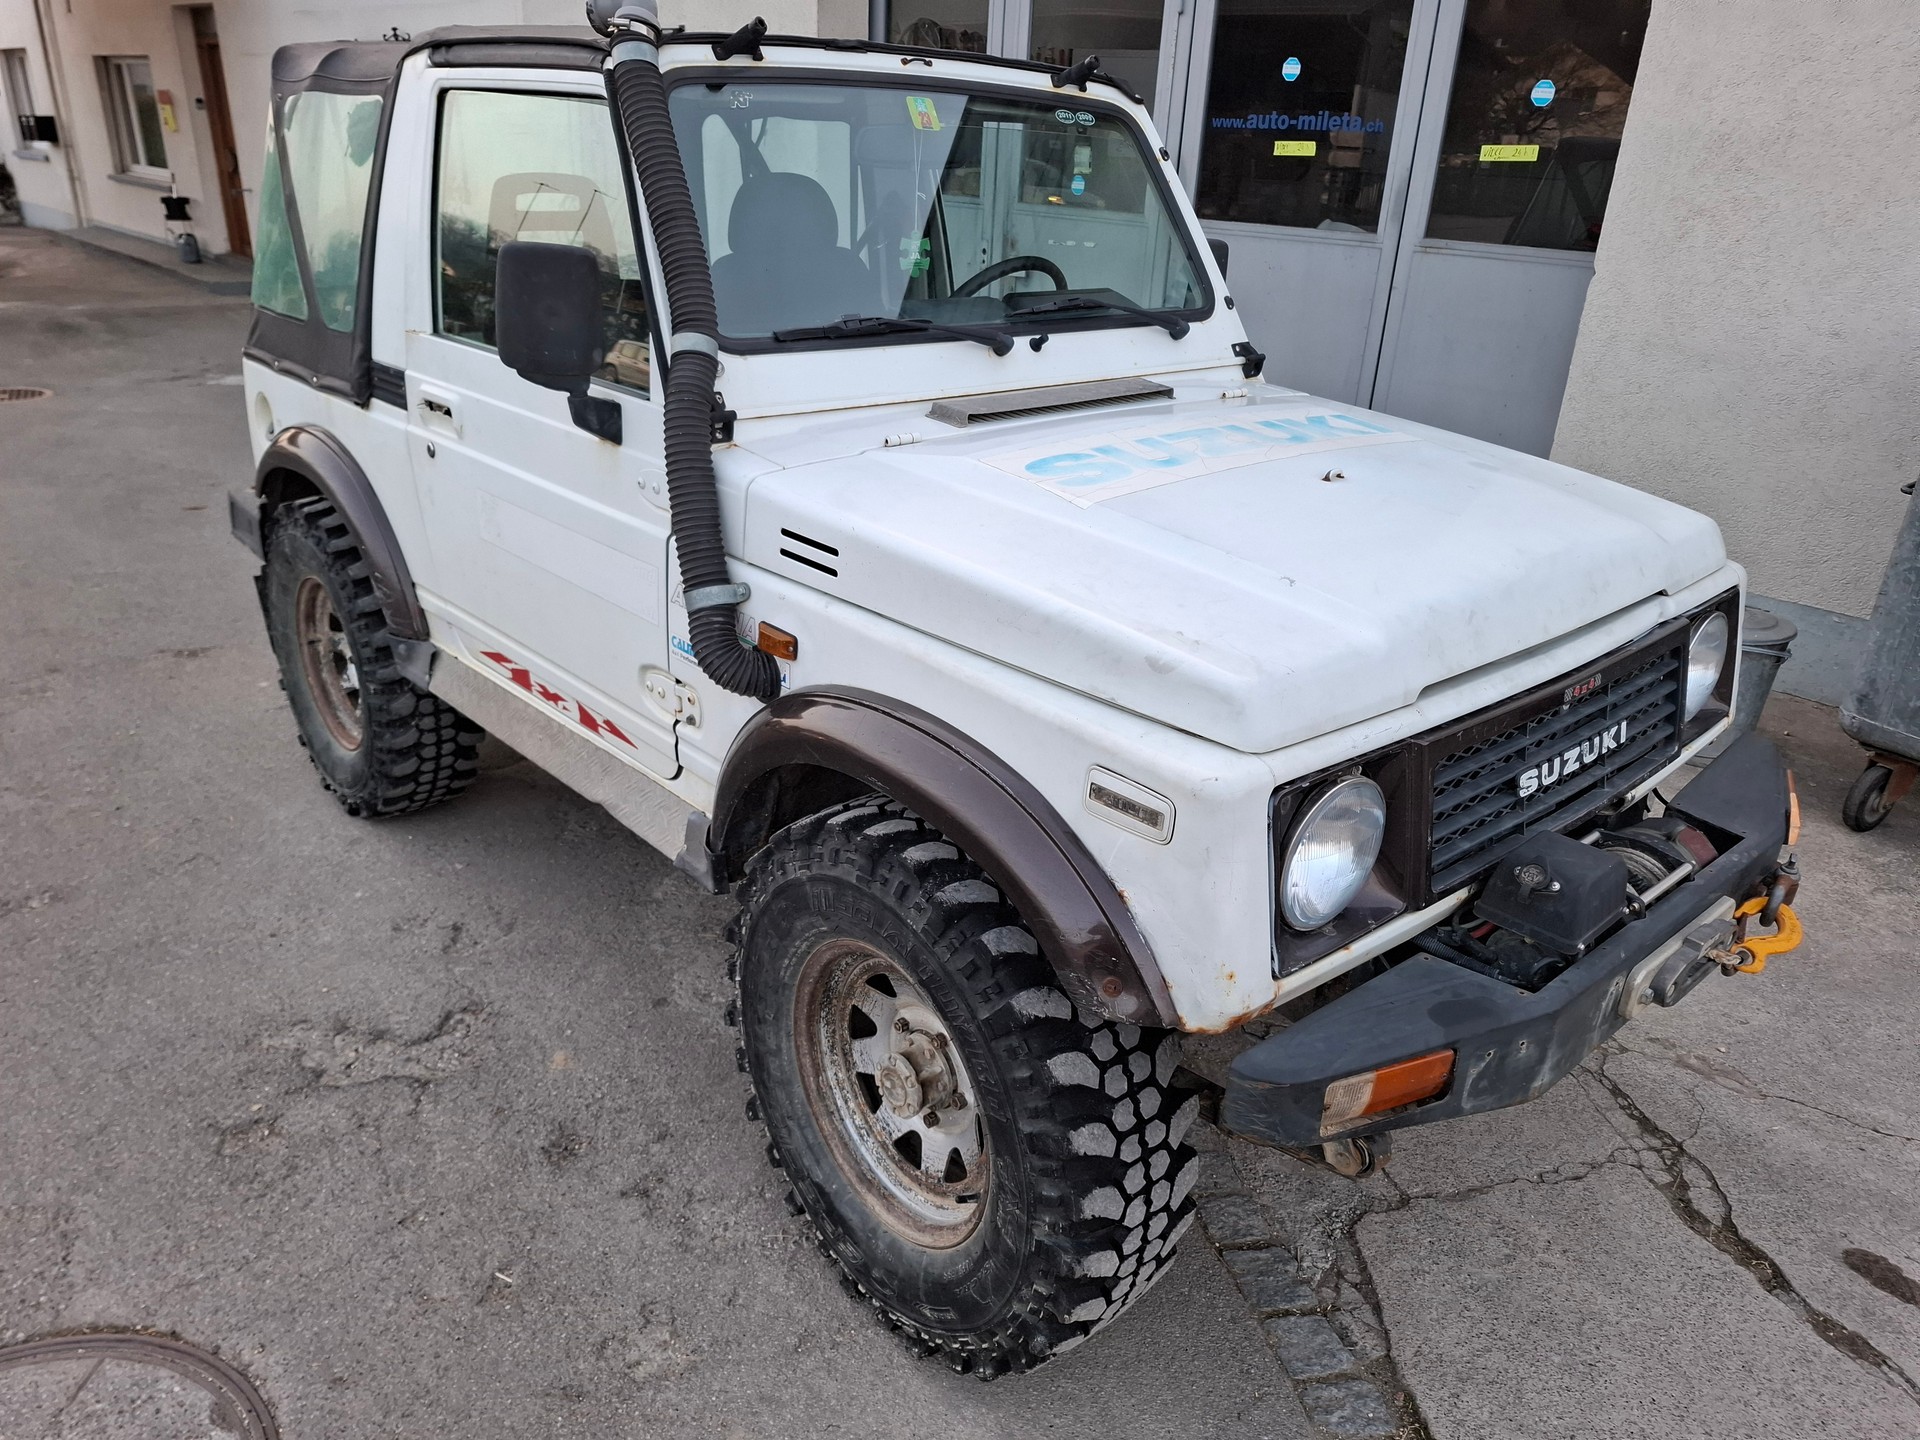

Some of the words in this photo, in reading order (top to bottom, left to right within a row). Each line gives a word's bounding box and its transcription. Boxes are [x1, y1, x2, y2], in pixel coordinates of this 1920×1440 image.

[1212, 111, 1384, 132] www.auto-mileta.ch
[1024, 414, 1395, 487] SUZUKI
[1518, 719, 1628, 798] SUZUKI
